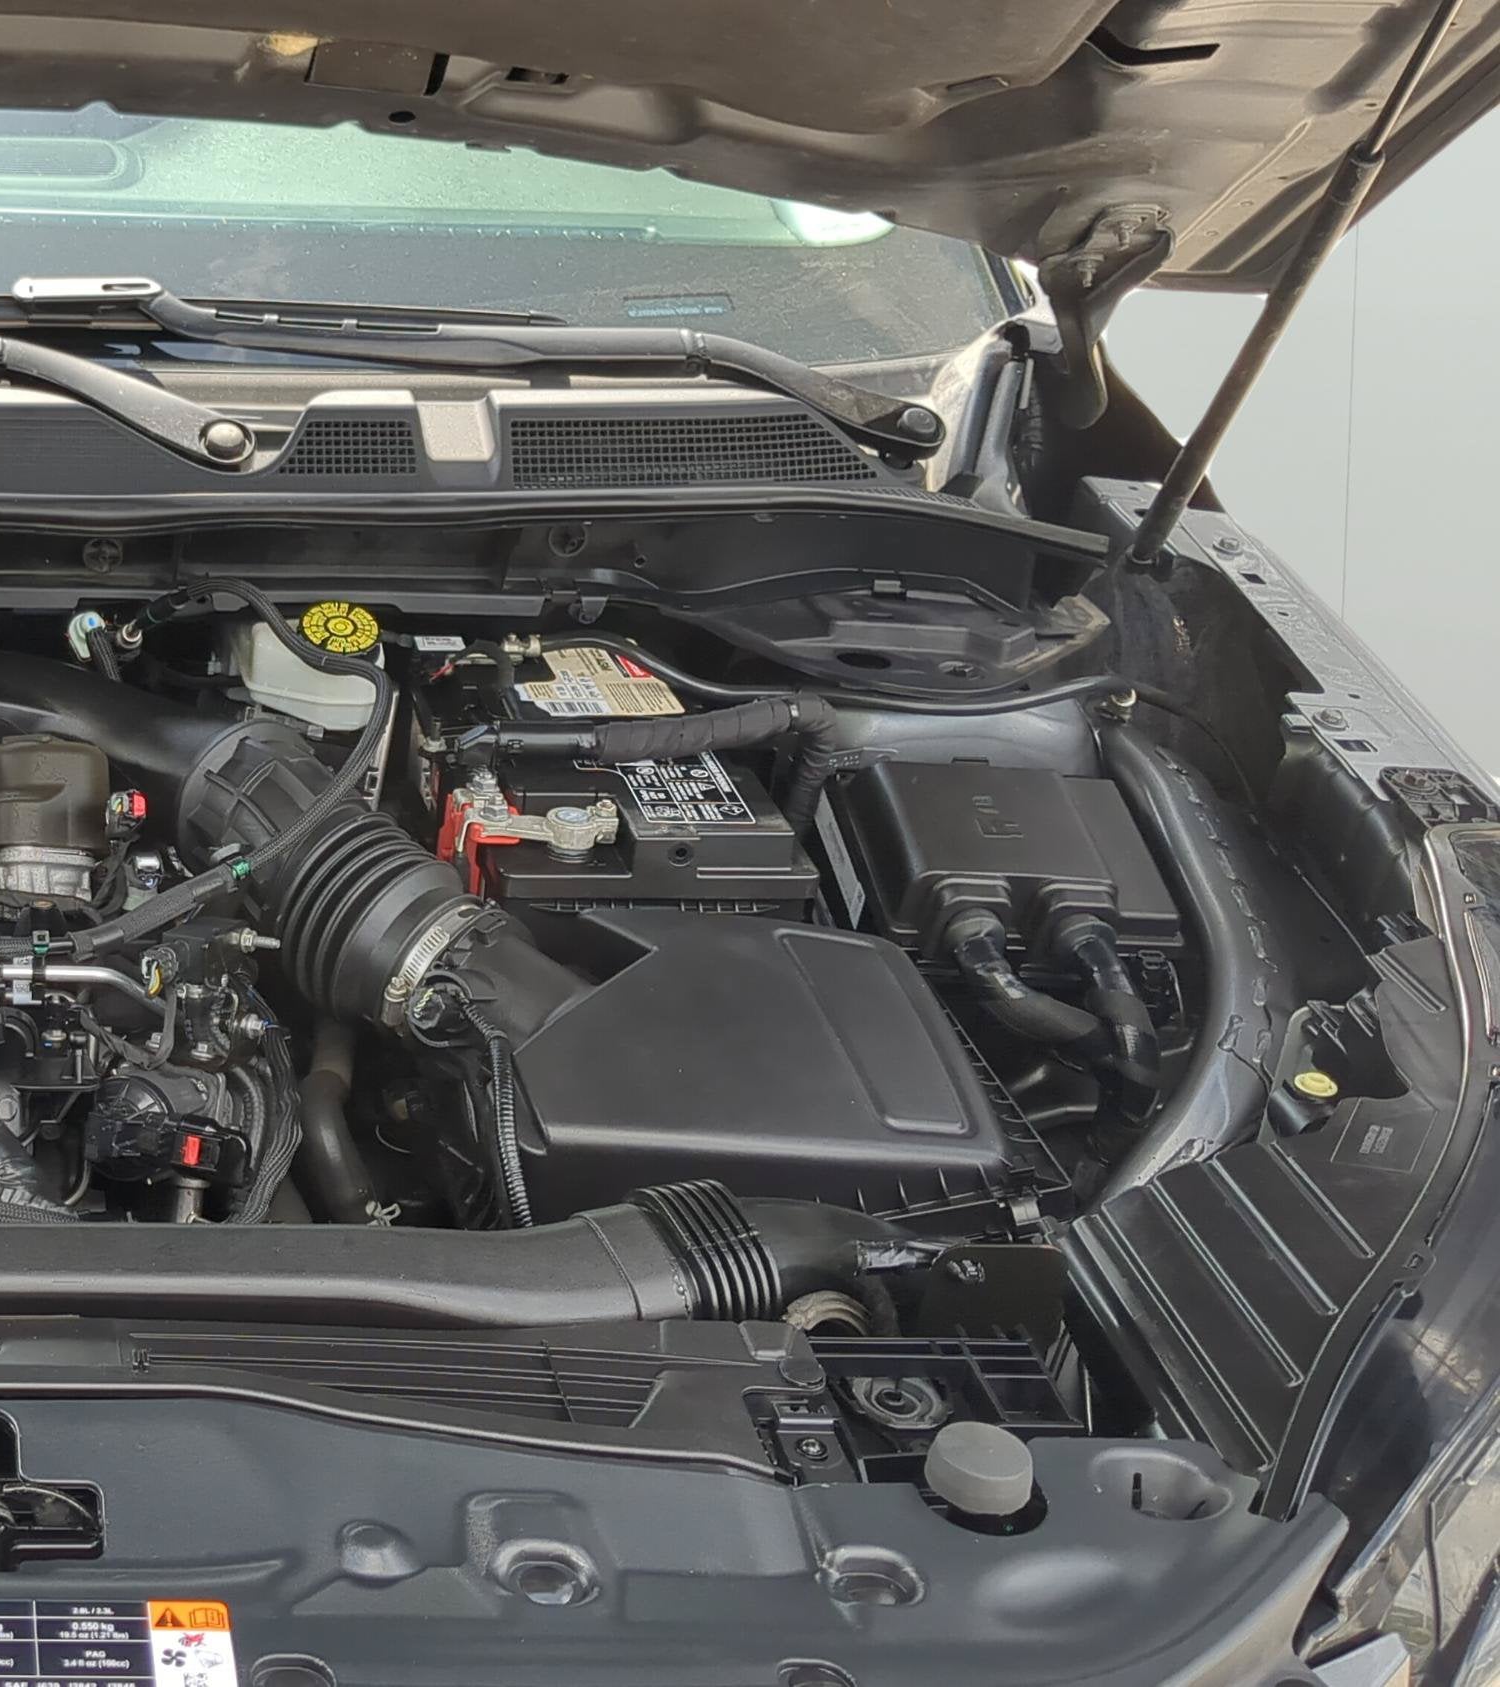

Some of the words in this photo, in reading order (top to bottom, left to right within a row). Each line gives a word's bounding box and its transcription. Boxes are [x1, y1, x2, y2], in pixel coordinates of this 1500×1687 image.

[72, 1622, 99, 1630] 0.550
[101, 1622, 115, 1632] kg
[85, 1650, 107, 1658] PAG
